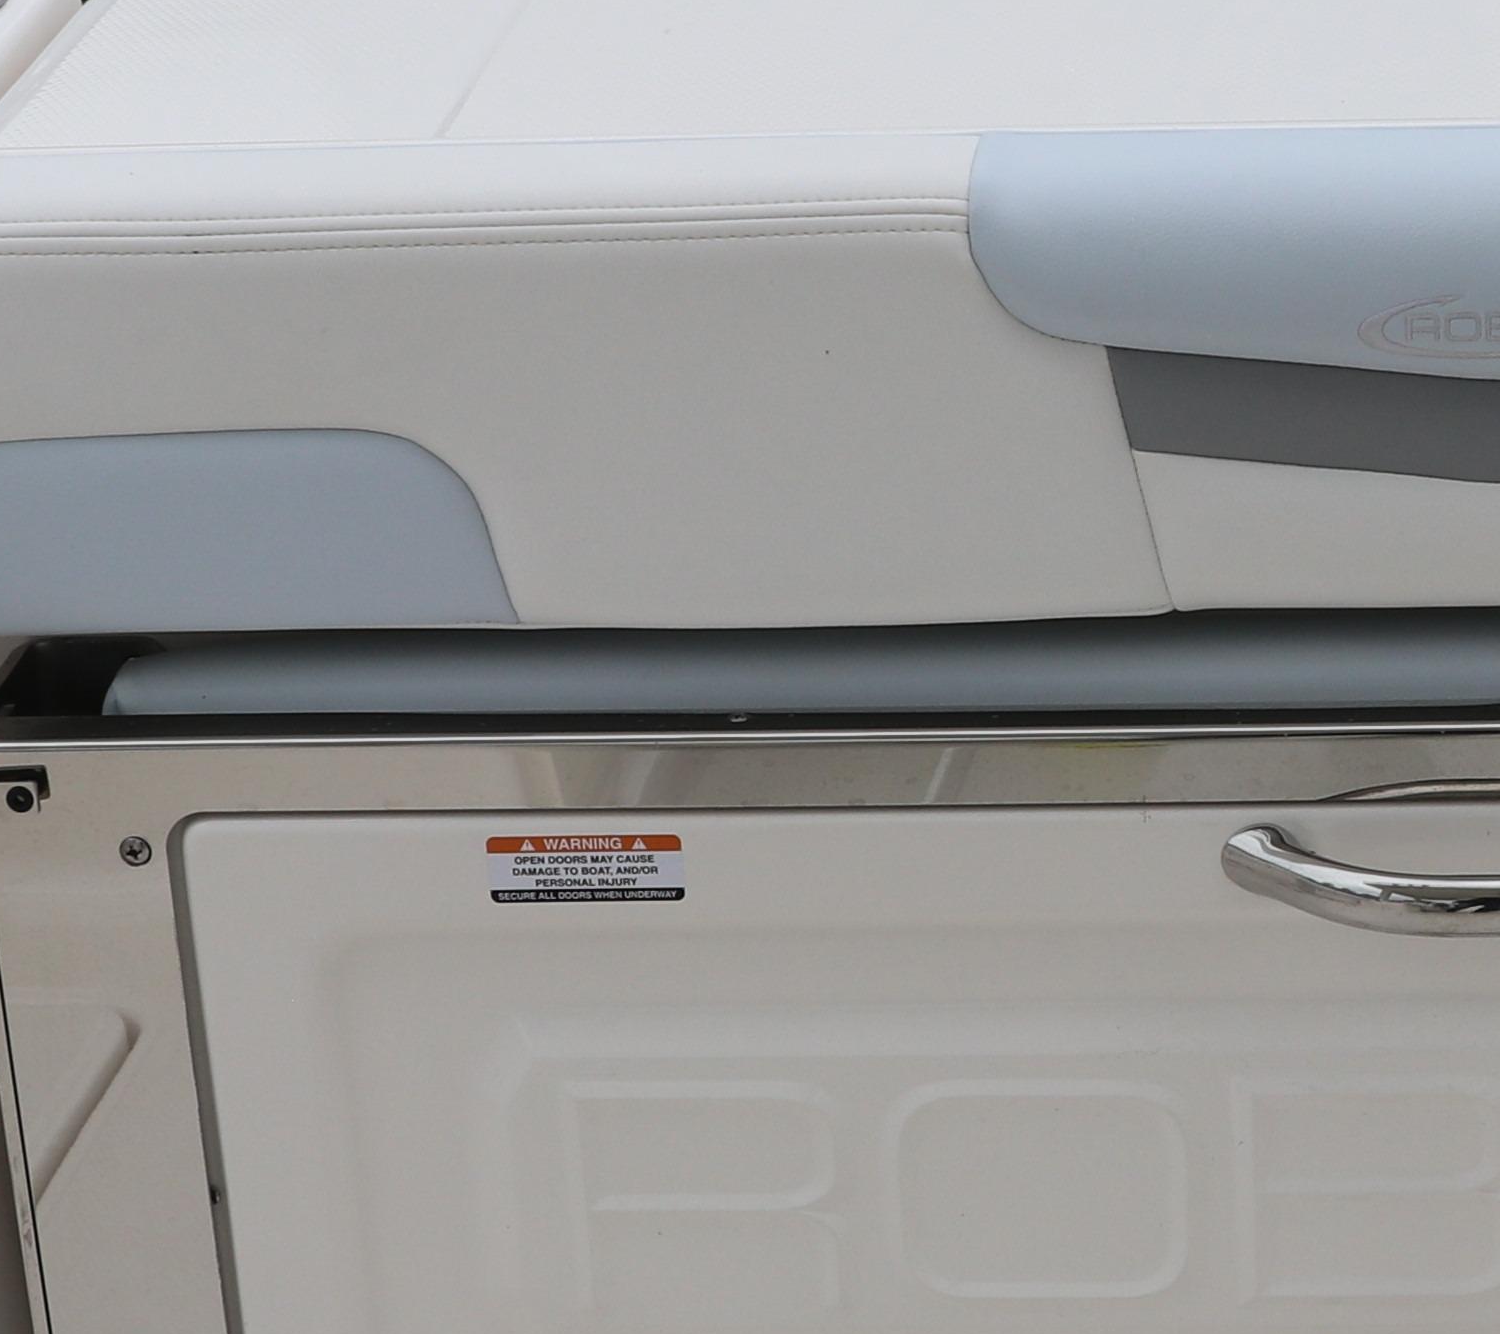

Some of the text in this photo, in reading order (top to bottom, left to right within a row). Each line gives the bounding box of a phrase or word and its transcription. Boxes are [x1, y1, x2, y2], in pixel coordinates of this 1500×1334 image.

[543, 837, 623, 851] WARNING
[514, 854, 655, 865] OPEN DOORS MAY CAUSE
[512, 865, 659, 877] DAMAGE TO BOAT, AND/OR
[535, 877, 638, 888] PERSONAL INJURY
[497, 890, 677, 901] SECURE ALL DOORS WHEN UNDERWAY
